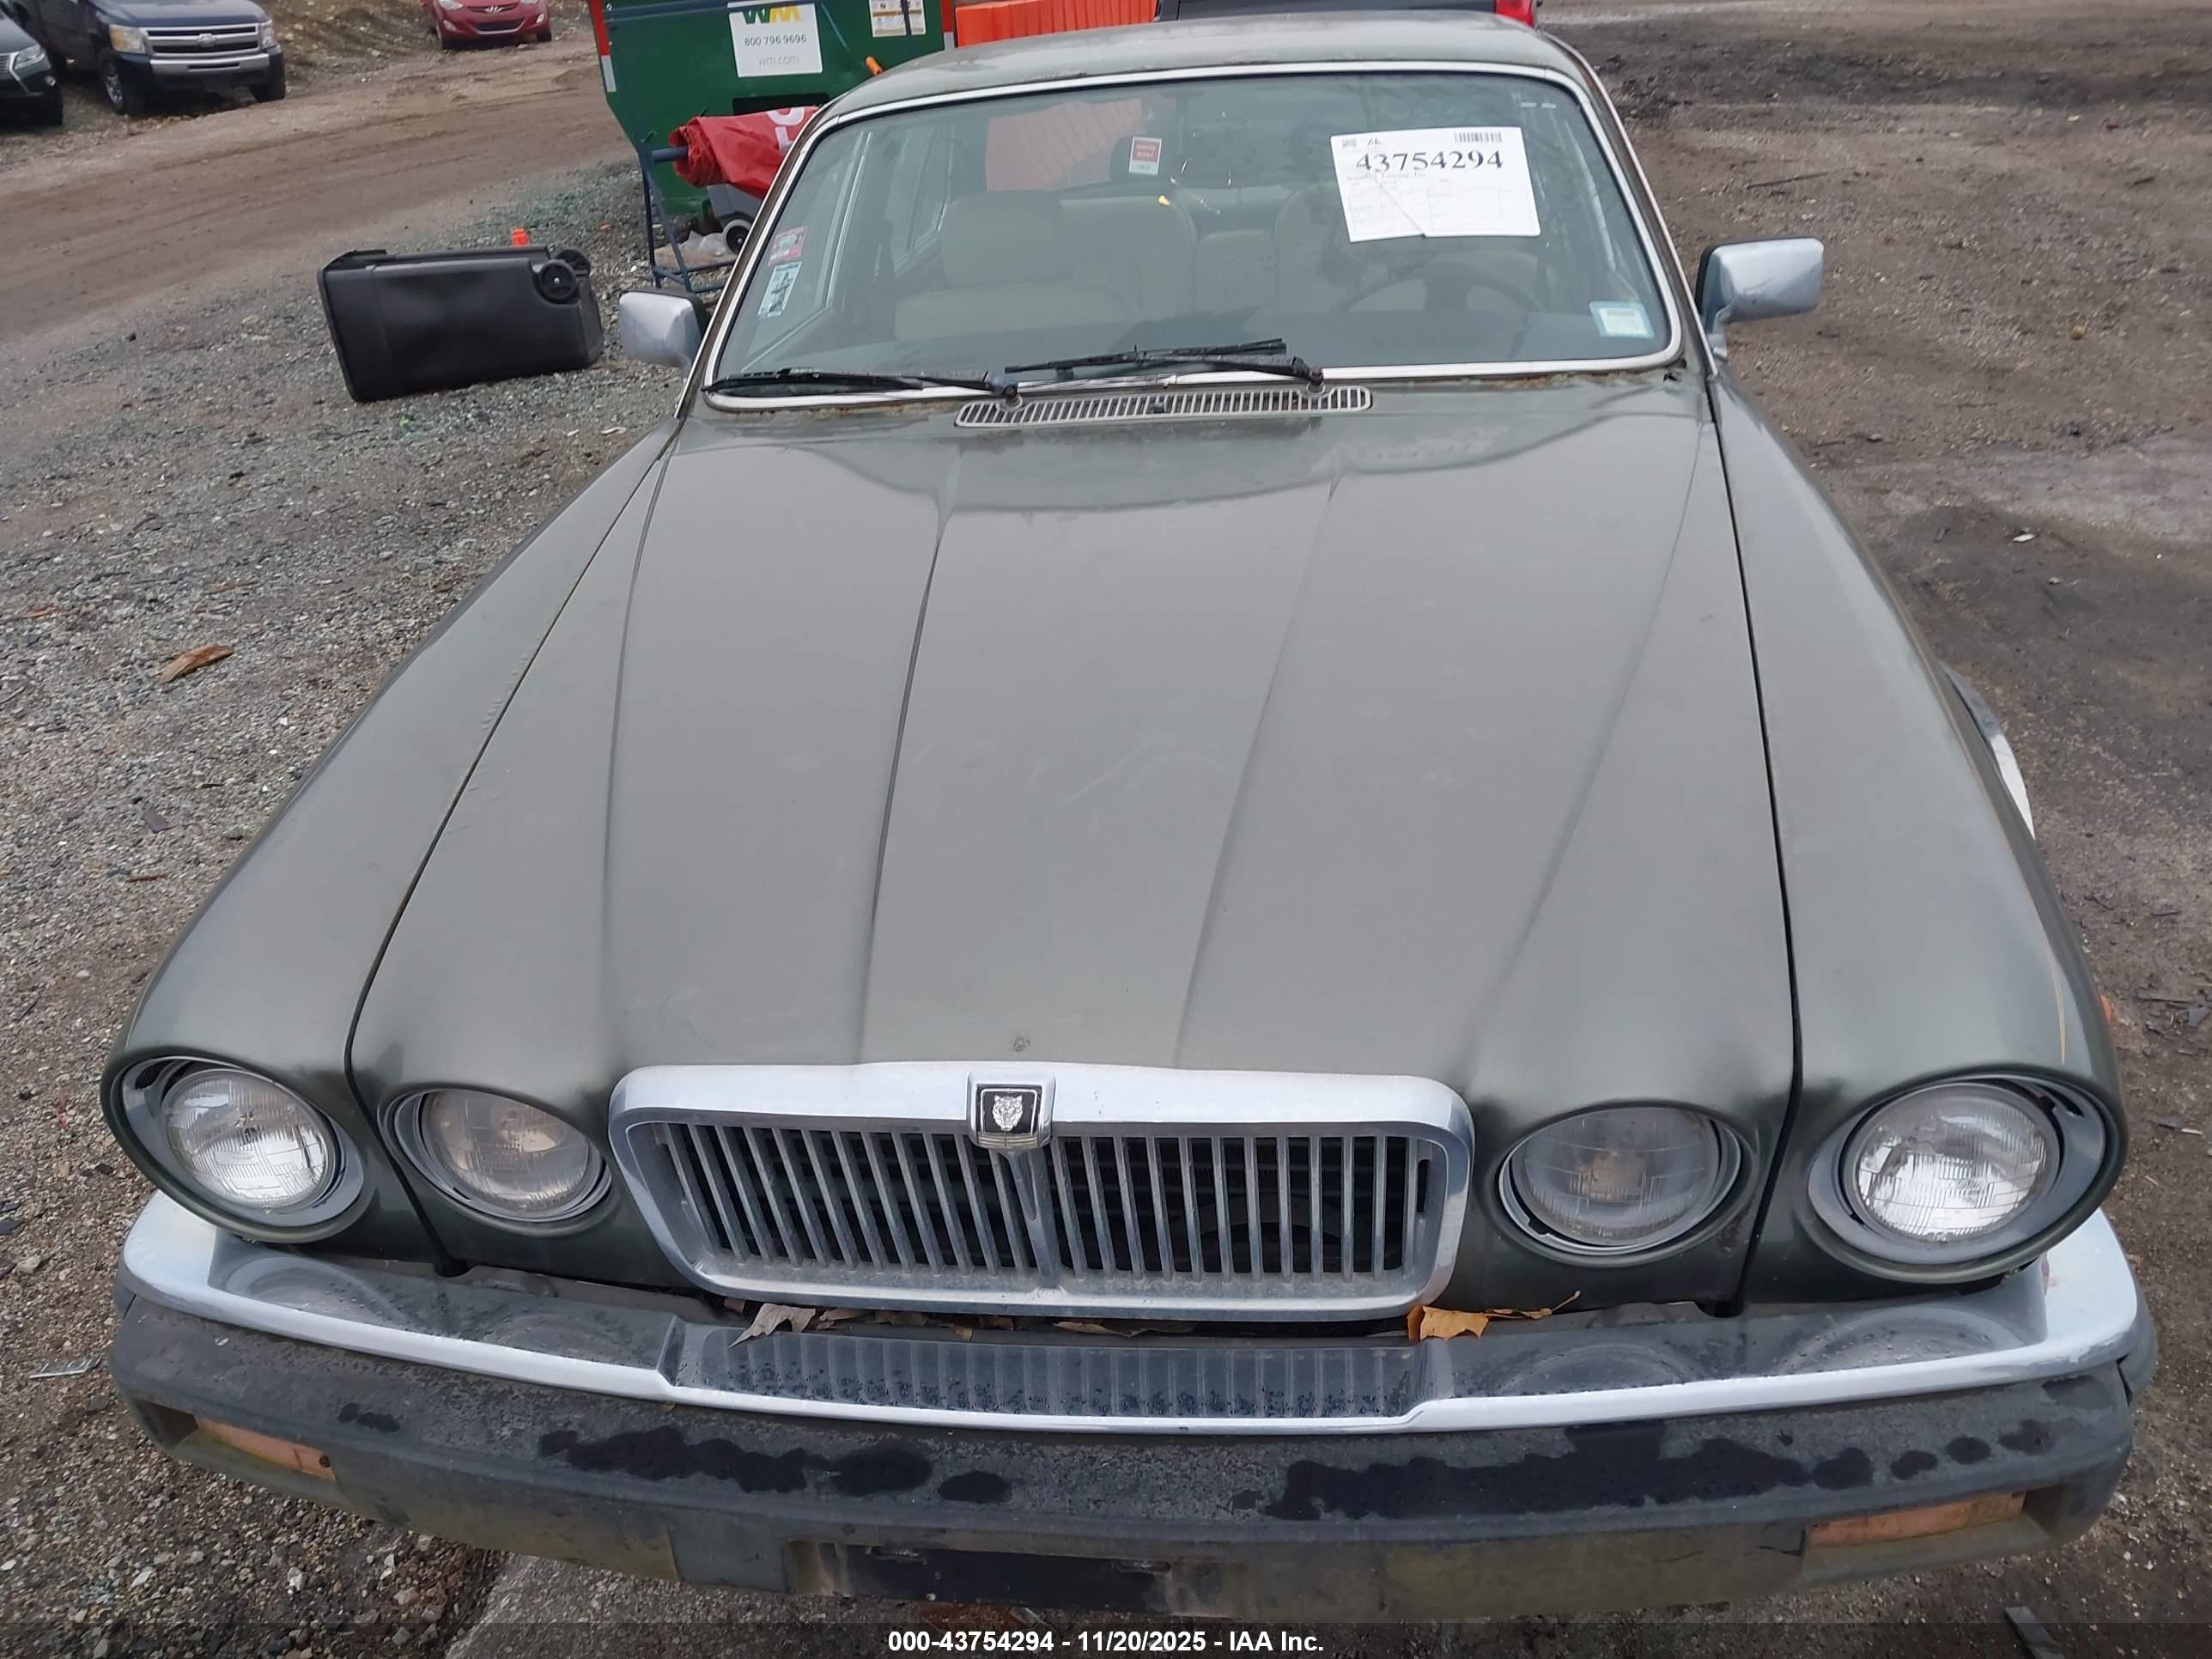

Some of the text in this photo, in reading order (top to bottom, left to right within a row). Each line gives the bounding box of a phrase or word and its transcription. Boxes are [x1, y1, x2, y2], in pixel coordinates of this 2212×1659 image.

[742, 5, 802, 24] WM
[744, 33, 807, 46] 800 796 9696
[757, 54, 799, 66] wm.com
[1356, 149, 1504, 173] 43754294
